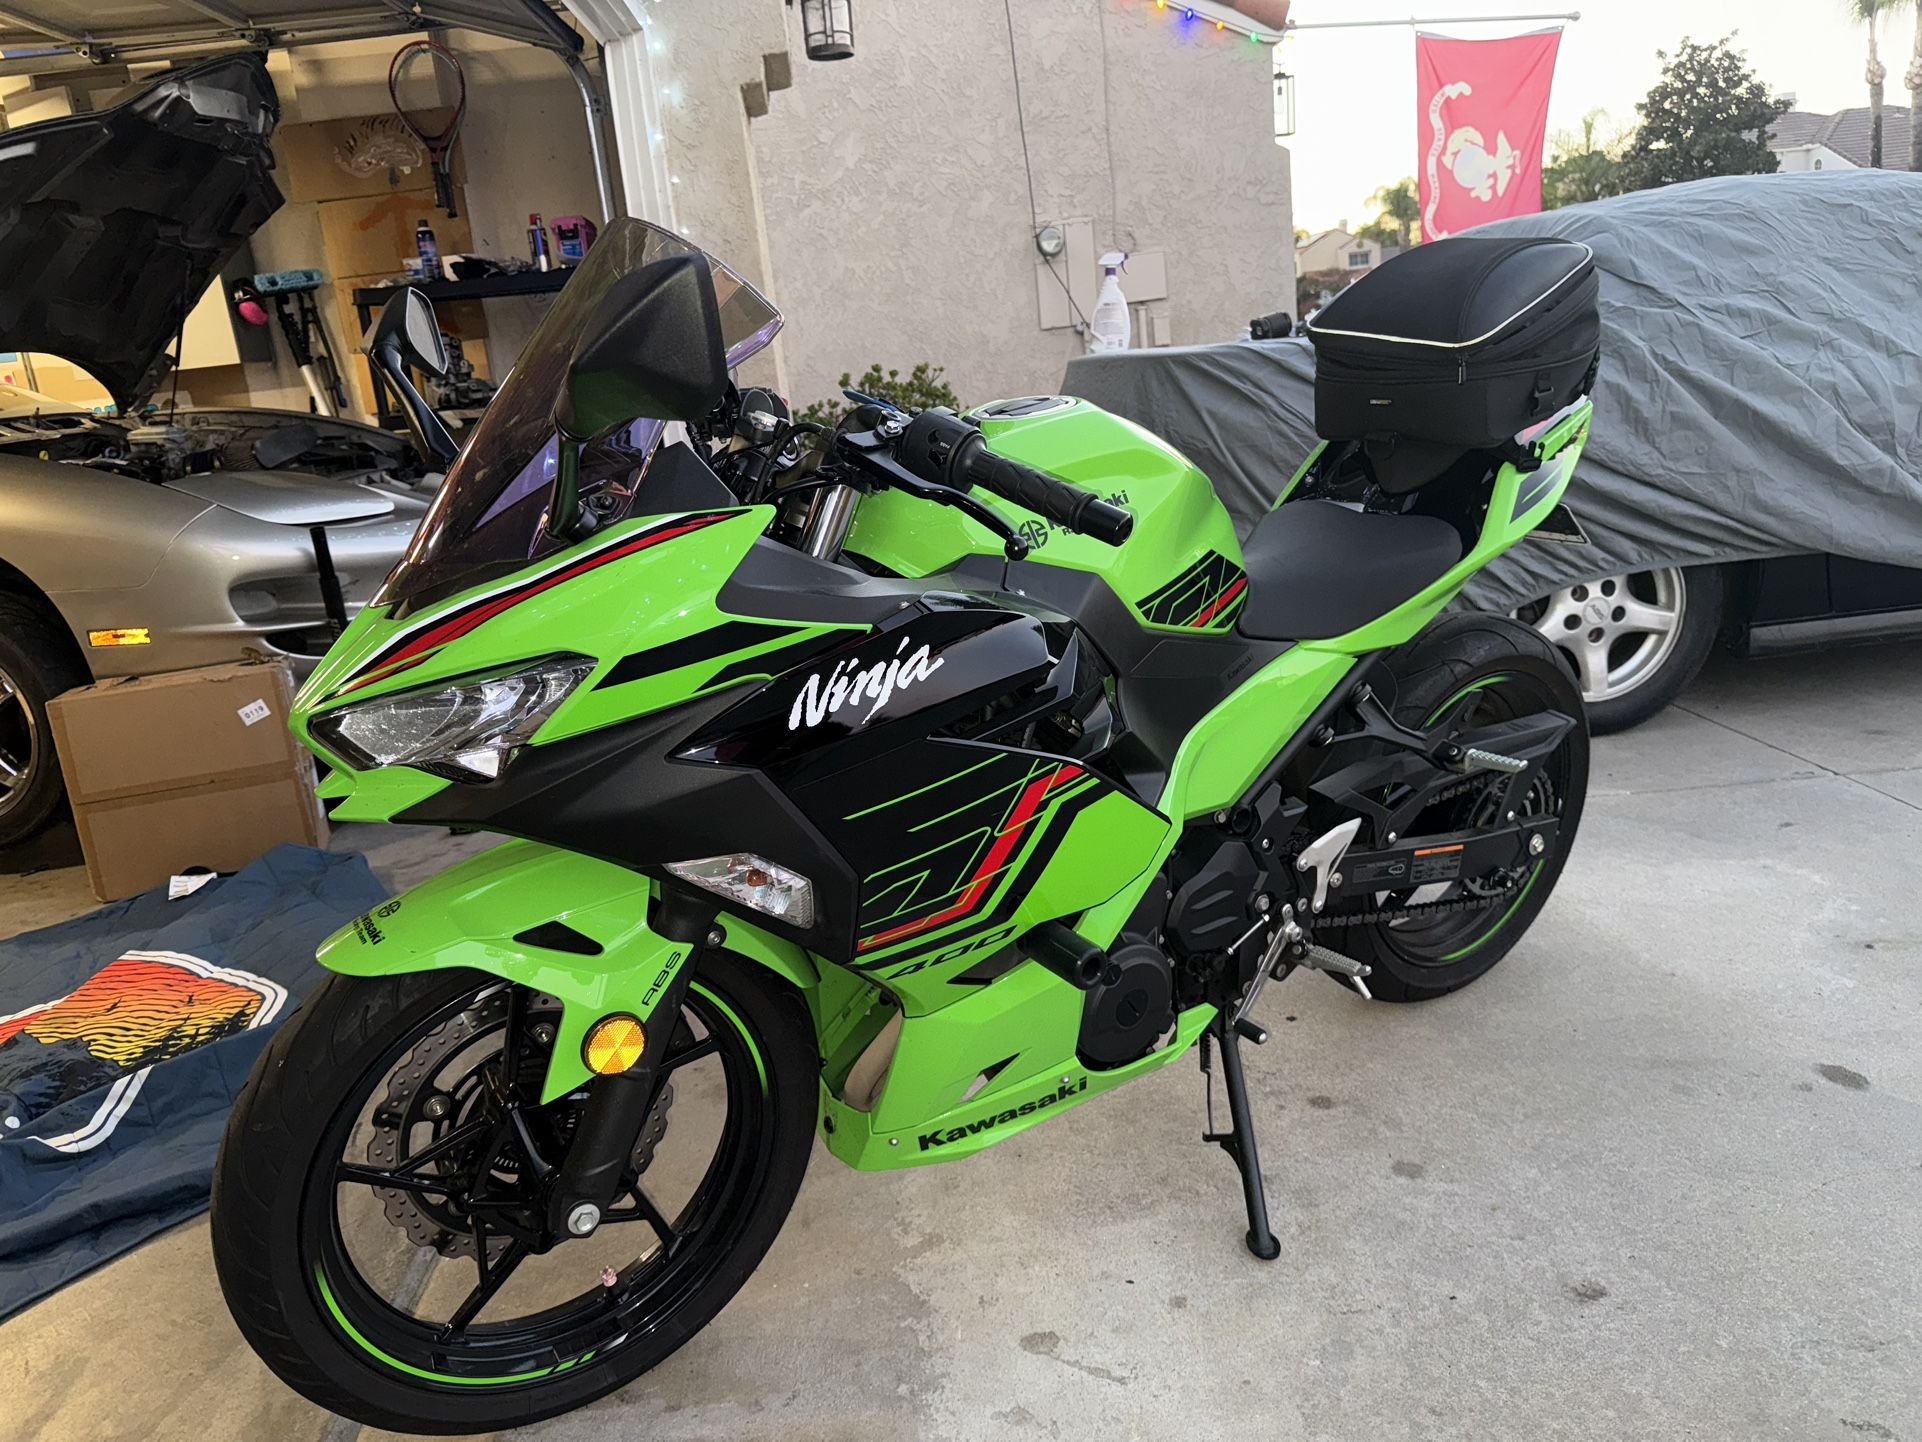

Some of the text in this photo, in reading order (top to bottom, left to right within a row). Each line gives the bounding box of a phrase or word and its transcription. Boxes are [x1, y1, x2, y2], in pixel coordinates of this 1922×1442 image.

[788, 636, 945, 731] Ninja
[641, 950, 681, 1007] ABS
[886, 924, 1018, 980] 400
[917, 1075, 1088, 1151] Kawasaki
